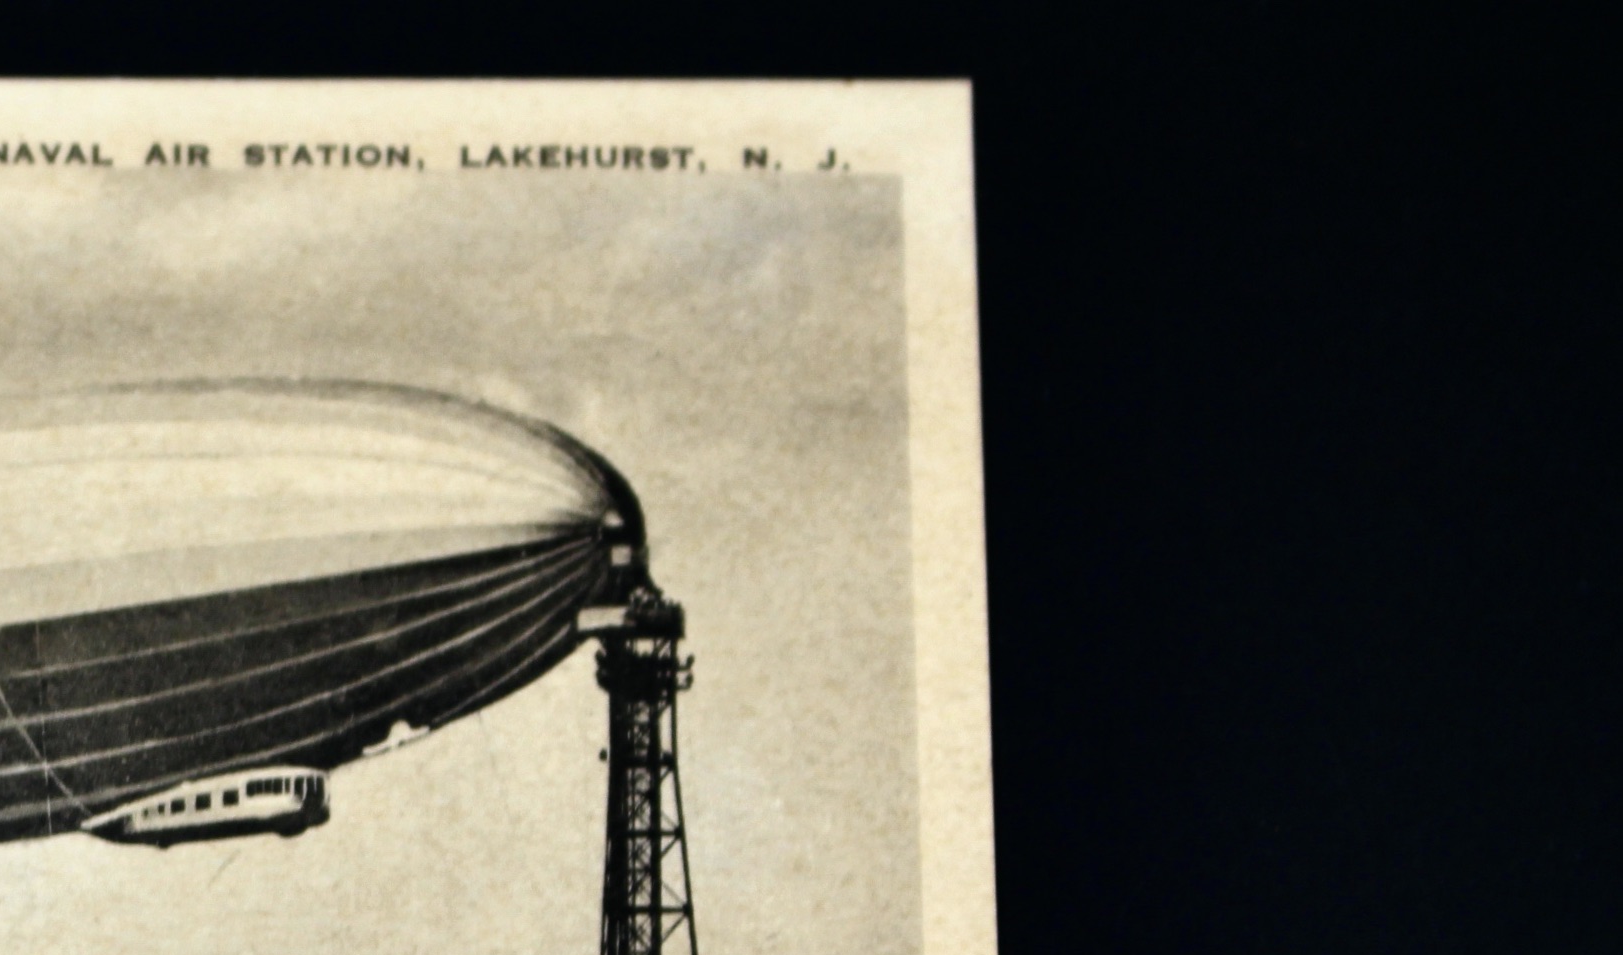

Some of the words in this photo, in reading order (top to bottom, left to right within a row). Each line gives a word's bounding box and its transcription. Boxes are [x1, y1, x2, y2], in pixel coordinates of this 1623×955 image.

[143, 142, 211, 167] AIR
[242, 144, 425, 170] STATION,
[459, 145, 707, 173] LAKEHURST,
[817, 149, 851, 171] J.
